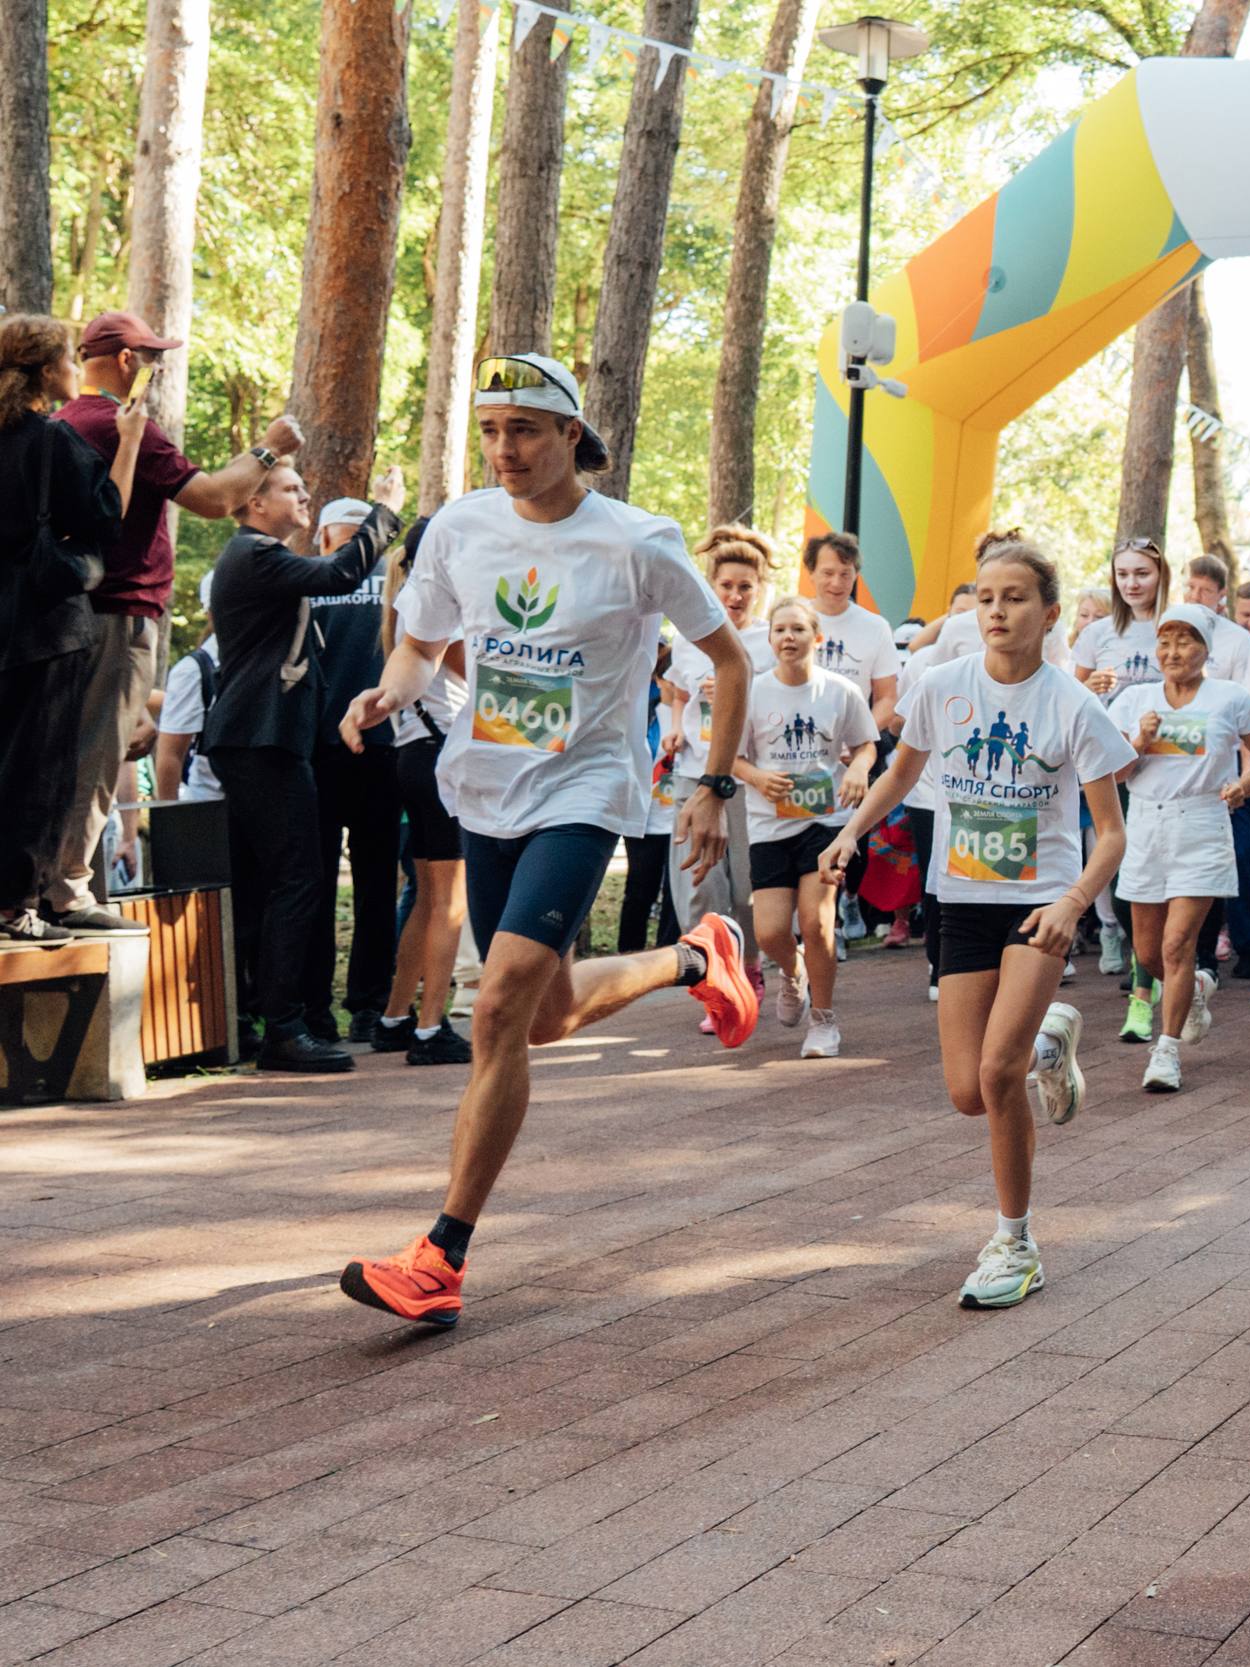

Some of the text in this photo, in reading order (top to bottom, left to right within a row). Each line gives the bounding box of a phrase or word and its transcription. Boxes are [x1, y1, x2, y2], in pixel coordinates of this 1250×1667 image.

[479, 692, 566, 732] 0460
[990, 783, 1060, 800] СПОРТА
[955, 829, 1028, 862] 0185
